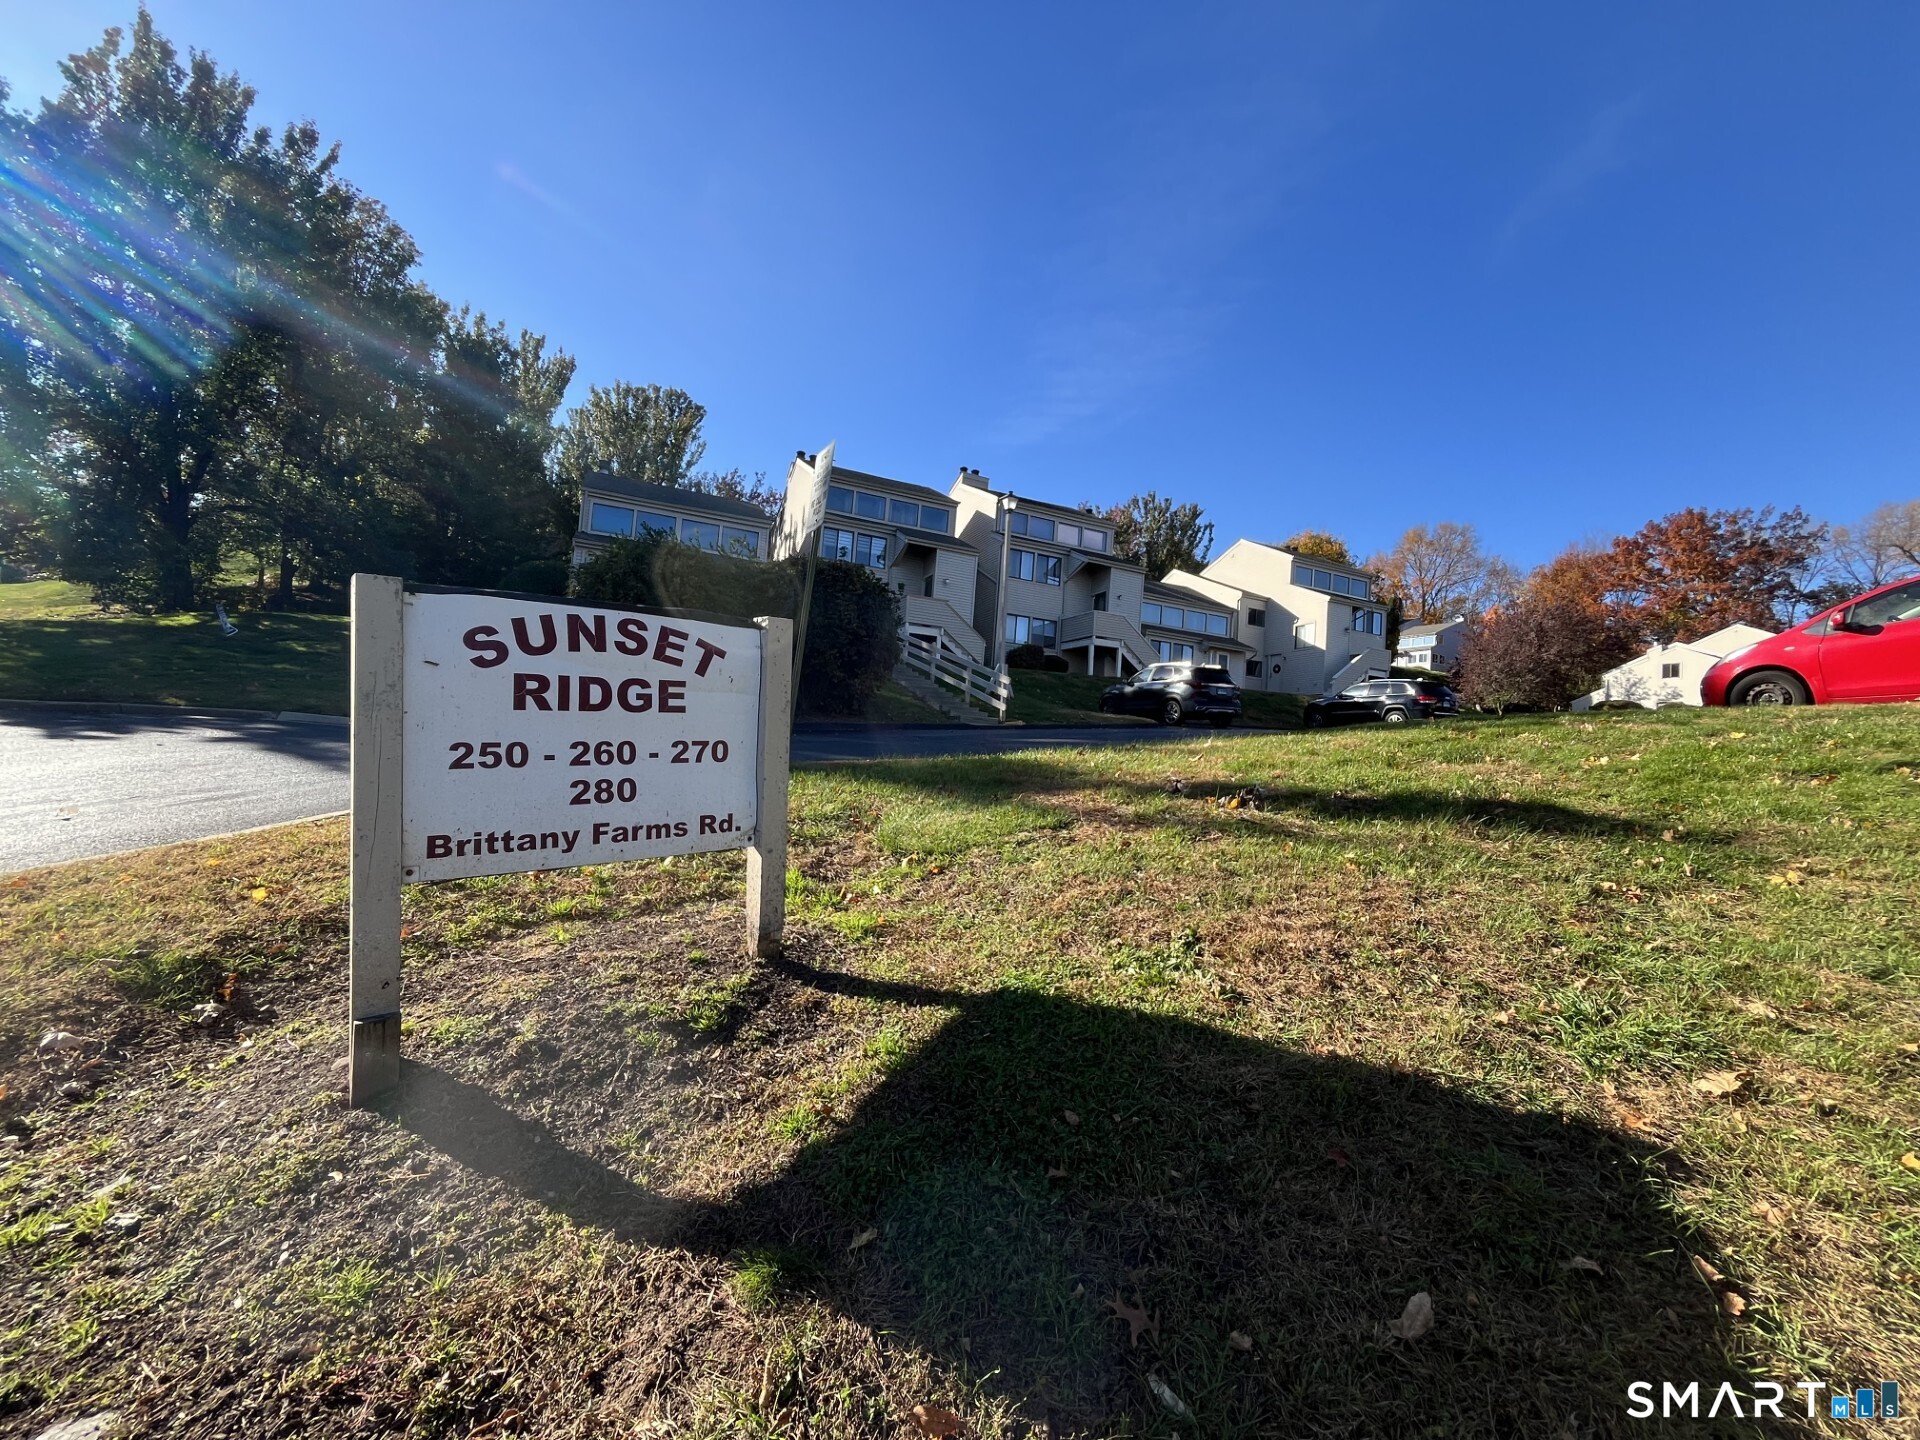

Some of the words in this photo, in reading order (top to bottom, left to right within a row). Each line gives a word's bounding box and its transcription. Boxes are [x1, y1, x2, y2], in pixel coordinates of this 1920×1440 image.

[463, 614, 727, 678] SUNSET
[513, 673, 687, 713] RIDGE
[448, 742, 529, 770] 250
[569, 741, 637, 766] 260
[670, 740, 729, 763] 270
[569, 778, 637, 805] 280
[426, 829, 580, 860] Brittany
[592, 820, 688, 845] Farms
[699, 814, 742, 834] Rd.
